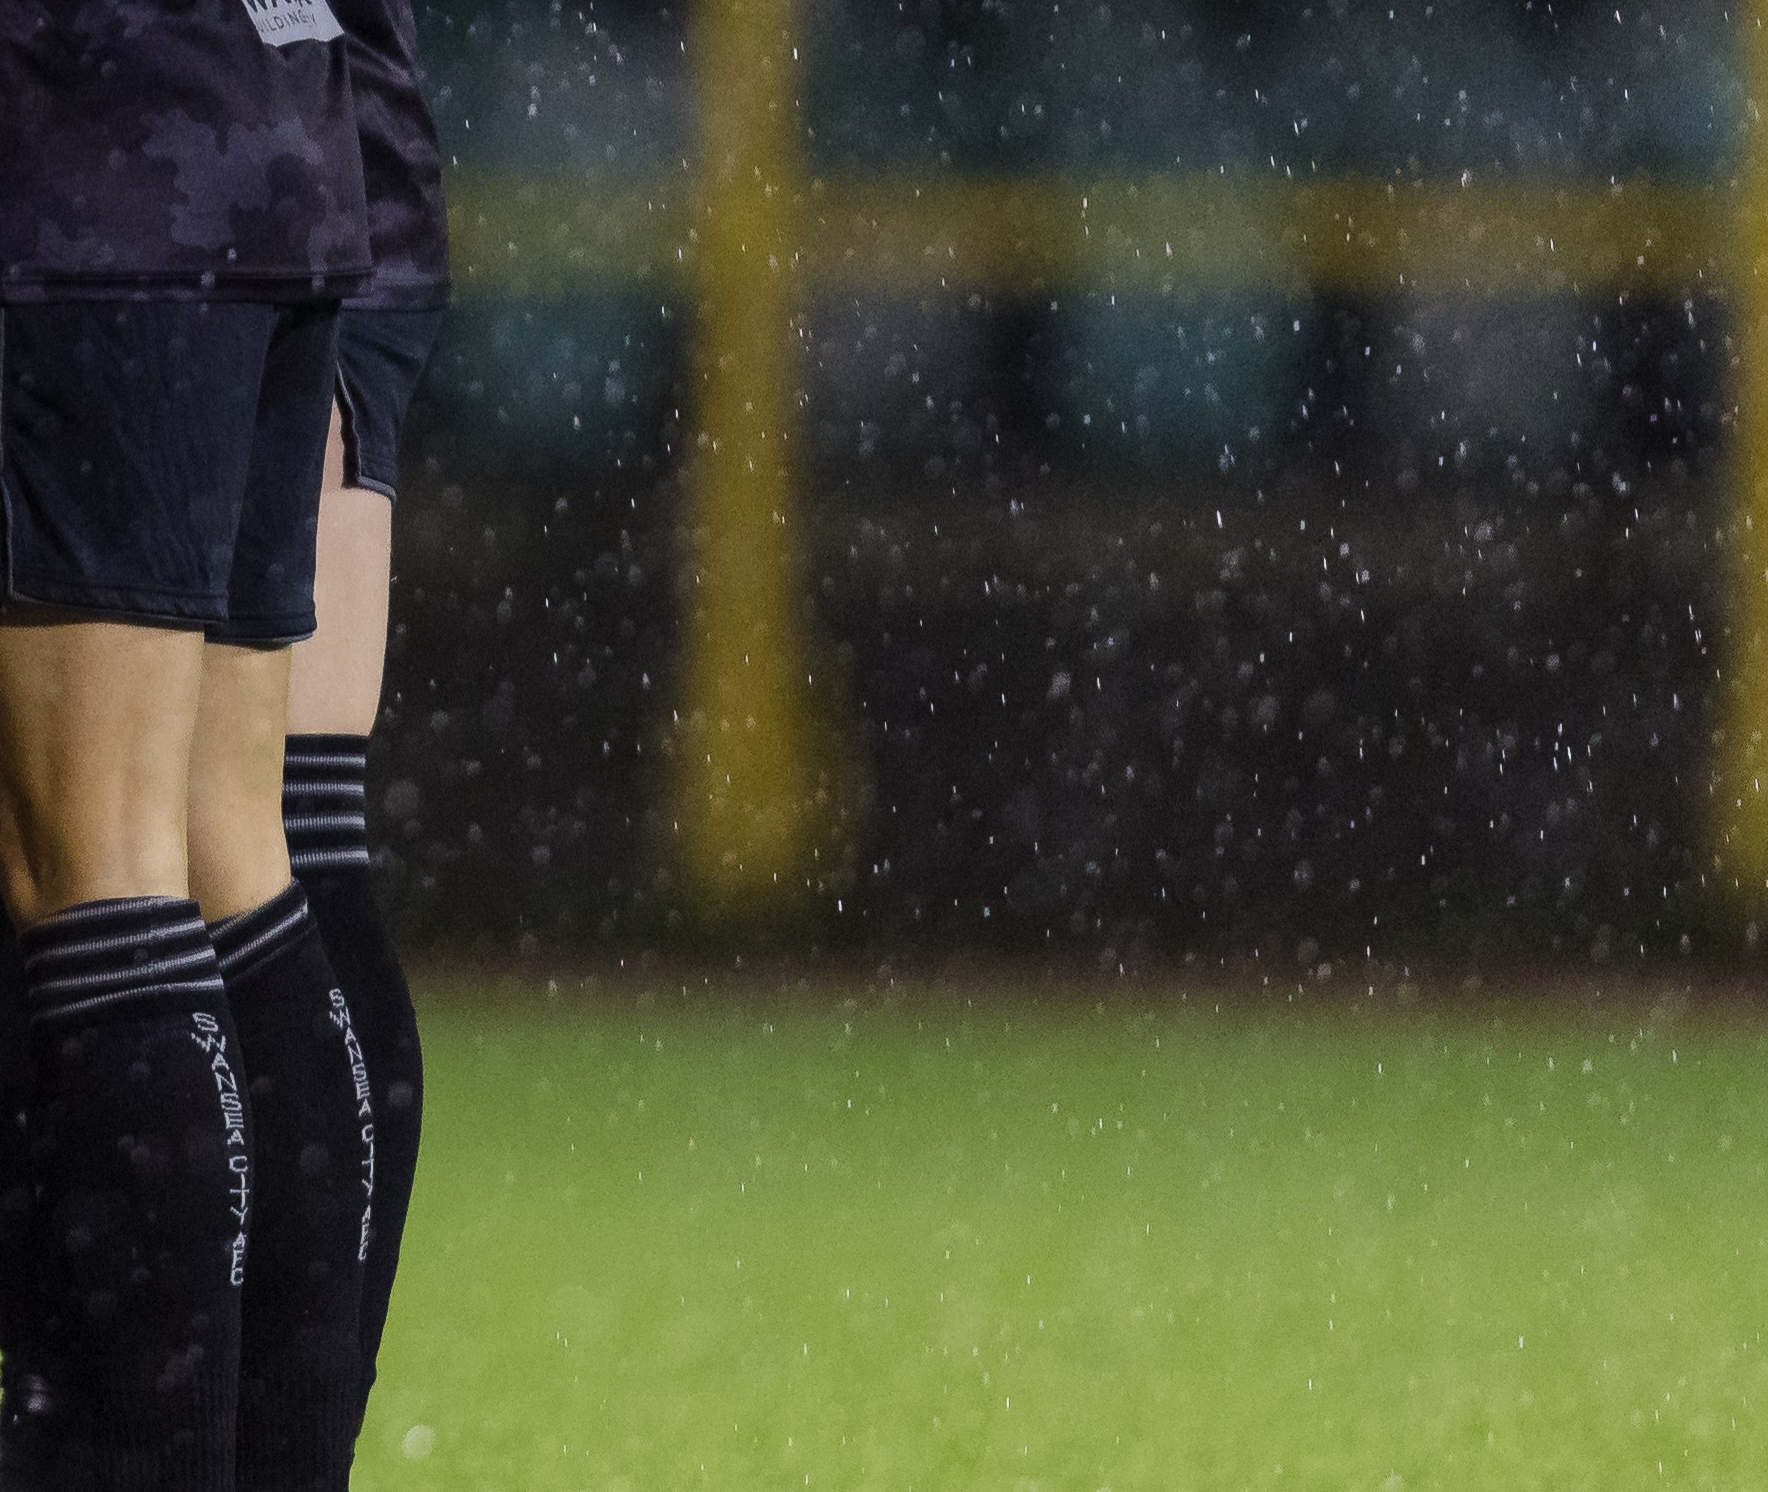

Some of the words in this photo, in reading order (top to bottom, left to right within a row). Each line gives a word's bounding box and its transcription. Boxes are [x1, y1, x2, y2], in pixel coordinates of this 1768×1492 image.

[191, 1012, 245, 1146] SWANSEA
[329, 988, 372, 1117] SWANSEA
[229, 1156, 250, 1225] CITY
[230, 1231, 247, 1286] AFC
